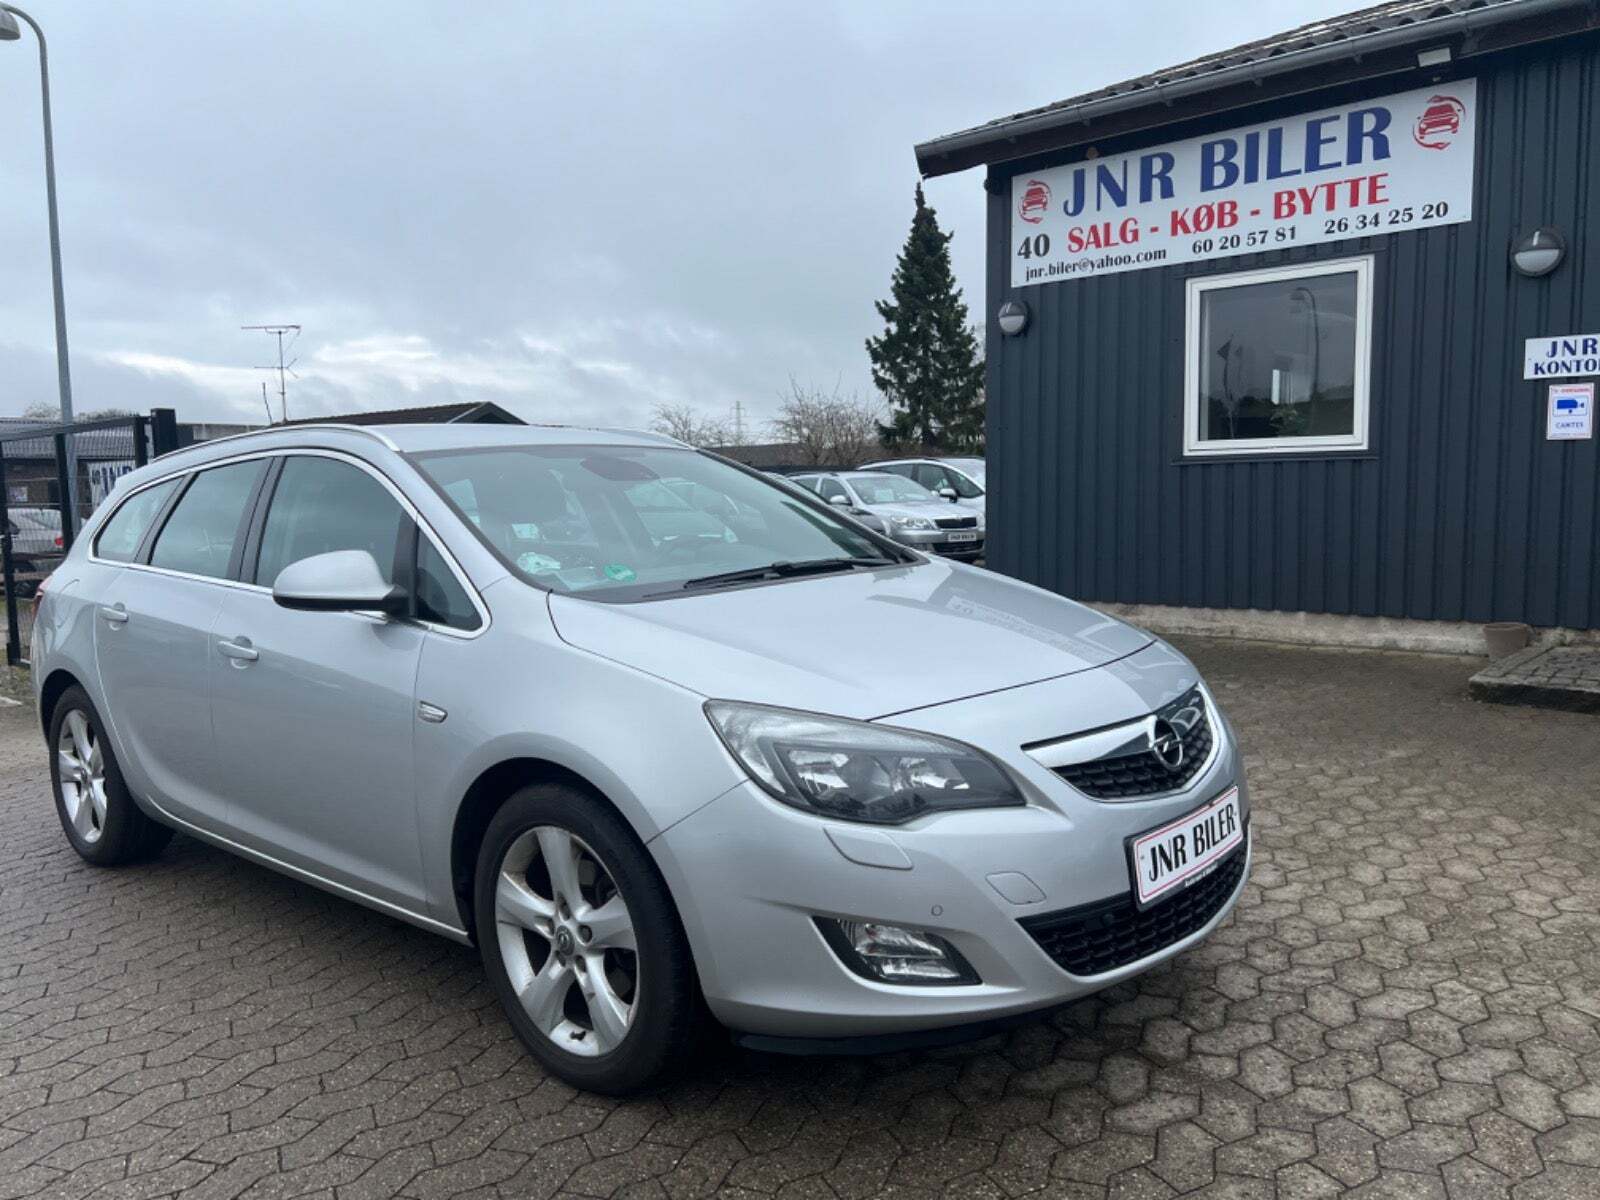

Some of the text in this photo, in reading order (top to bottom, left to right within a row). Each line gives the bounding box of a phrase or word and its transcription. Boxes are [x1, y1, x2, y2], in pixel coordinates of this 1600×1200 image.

[1063, 106, 1392, 217] JNR BILER
[1067, 173, 1390, 254] SALG - KØB - BYTTE
[1324, 201, 1449, 235] 26 34 25 20
[1017, 233, 1050, 260] 40
[1192, 226, 1297, 255] 60 20 57 81
[1025, 248, 1167, 281] jnr.biler@yahoo.com
[1546, 337, 1598, 358] JNR
[1534, 358, 1600, 376] KONTO
[1149, 834, 1187, 882] JNR
[1193, 803, 1236, 858] BILER
